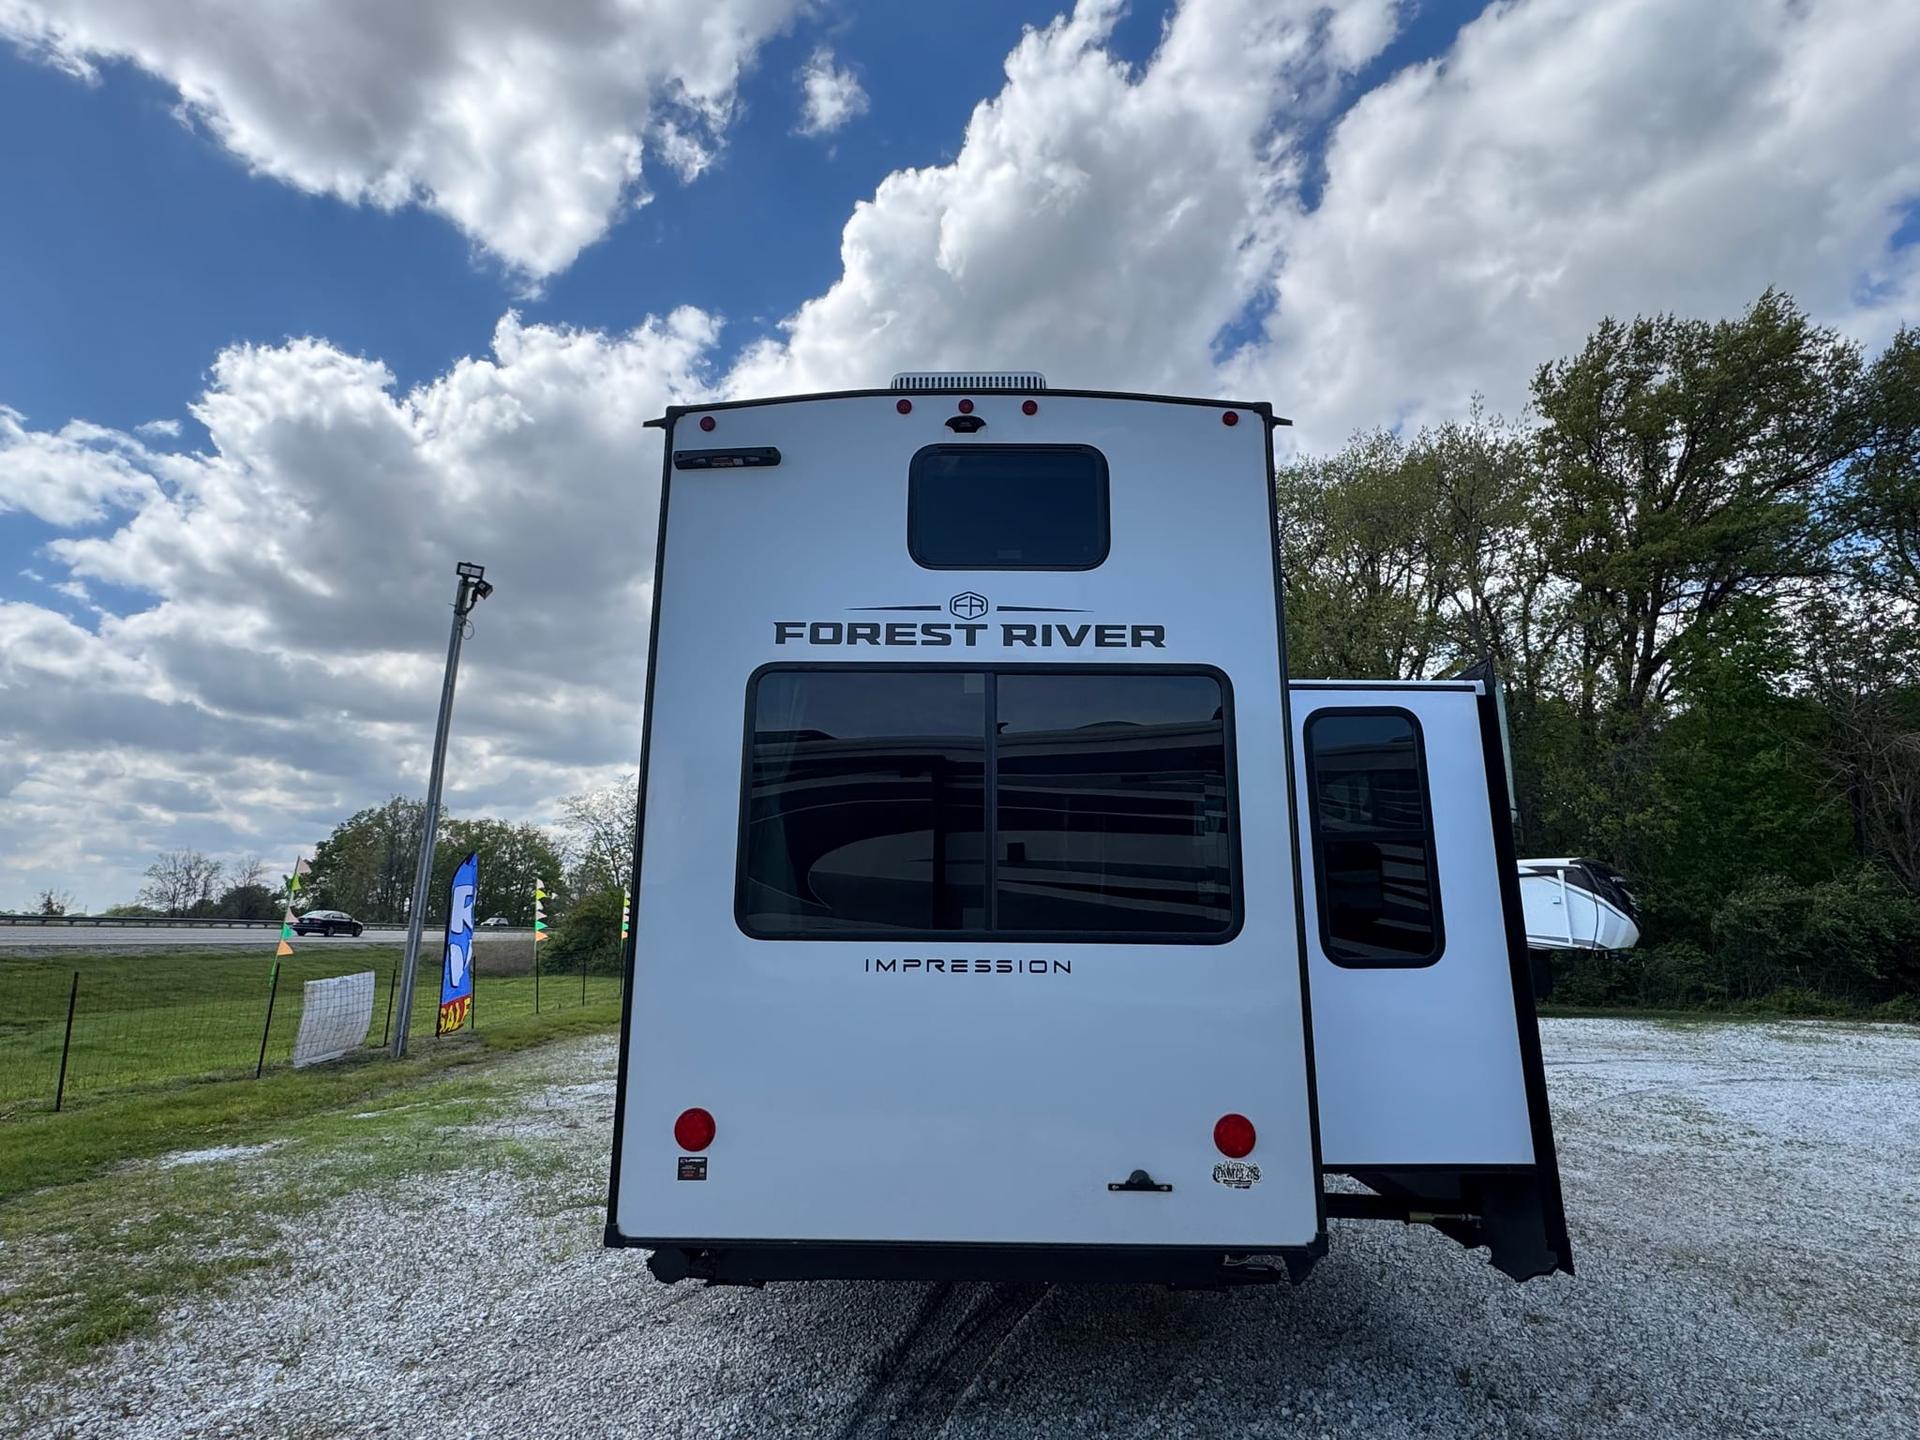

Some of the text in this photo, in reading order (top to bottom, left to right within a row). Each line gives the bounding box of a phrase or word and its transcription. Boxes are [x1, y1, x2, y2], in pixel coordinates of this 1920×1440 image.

[954, 595, 984, 617] FR
[774, 623, 1165, 647] FOREST RIVER
[866, 959, 1071, 973] IMPRESSION
[439, 997, 471, 1034] SALE
